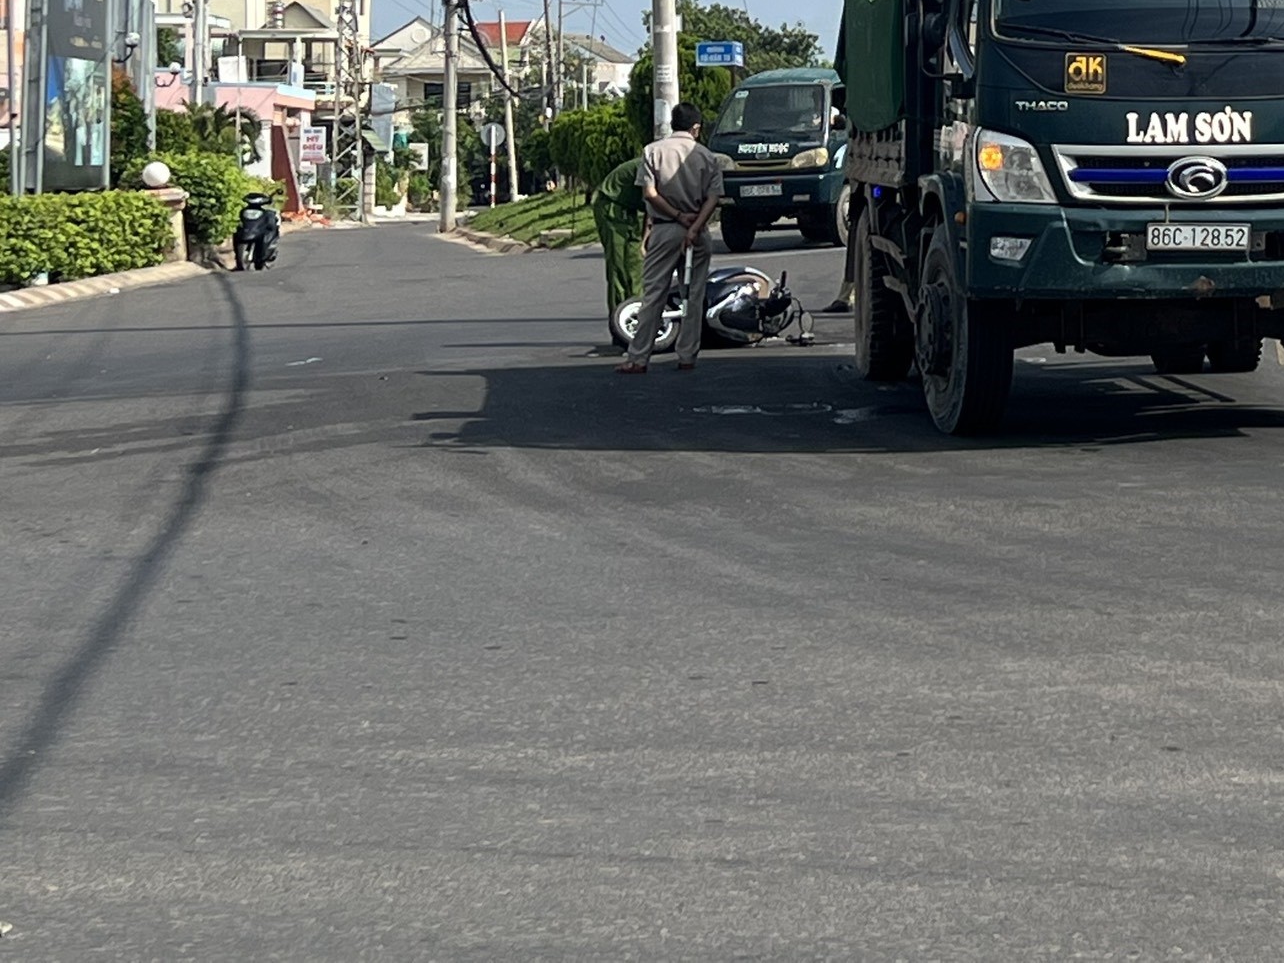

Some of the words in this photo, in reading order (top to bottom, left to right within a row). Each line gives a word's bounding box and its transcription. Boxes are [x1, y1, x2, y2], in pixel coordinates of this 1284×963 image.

[1015, 101, 1069, 111] THACO
[1126, 111, 1189, 143] LAM
[1194, 105, 1252, 143] SƠN
